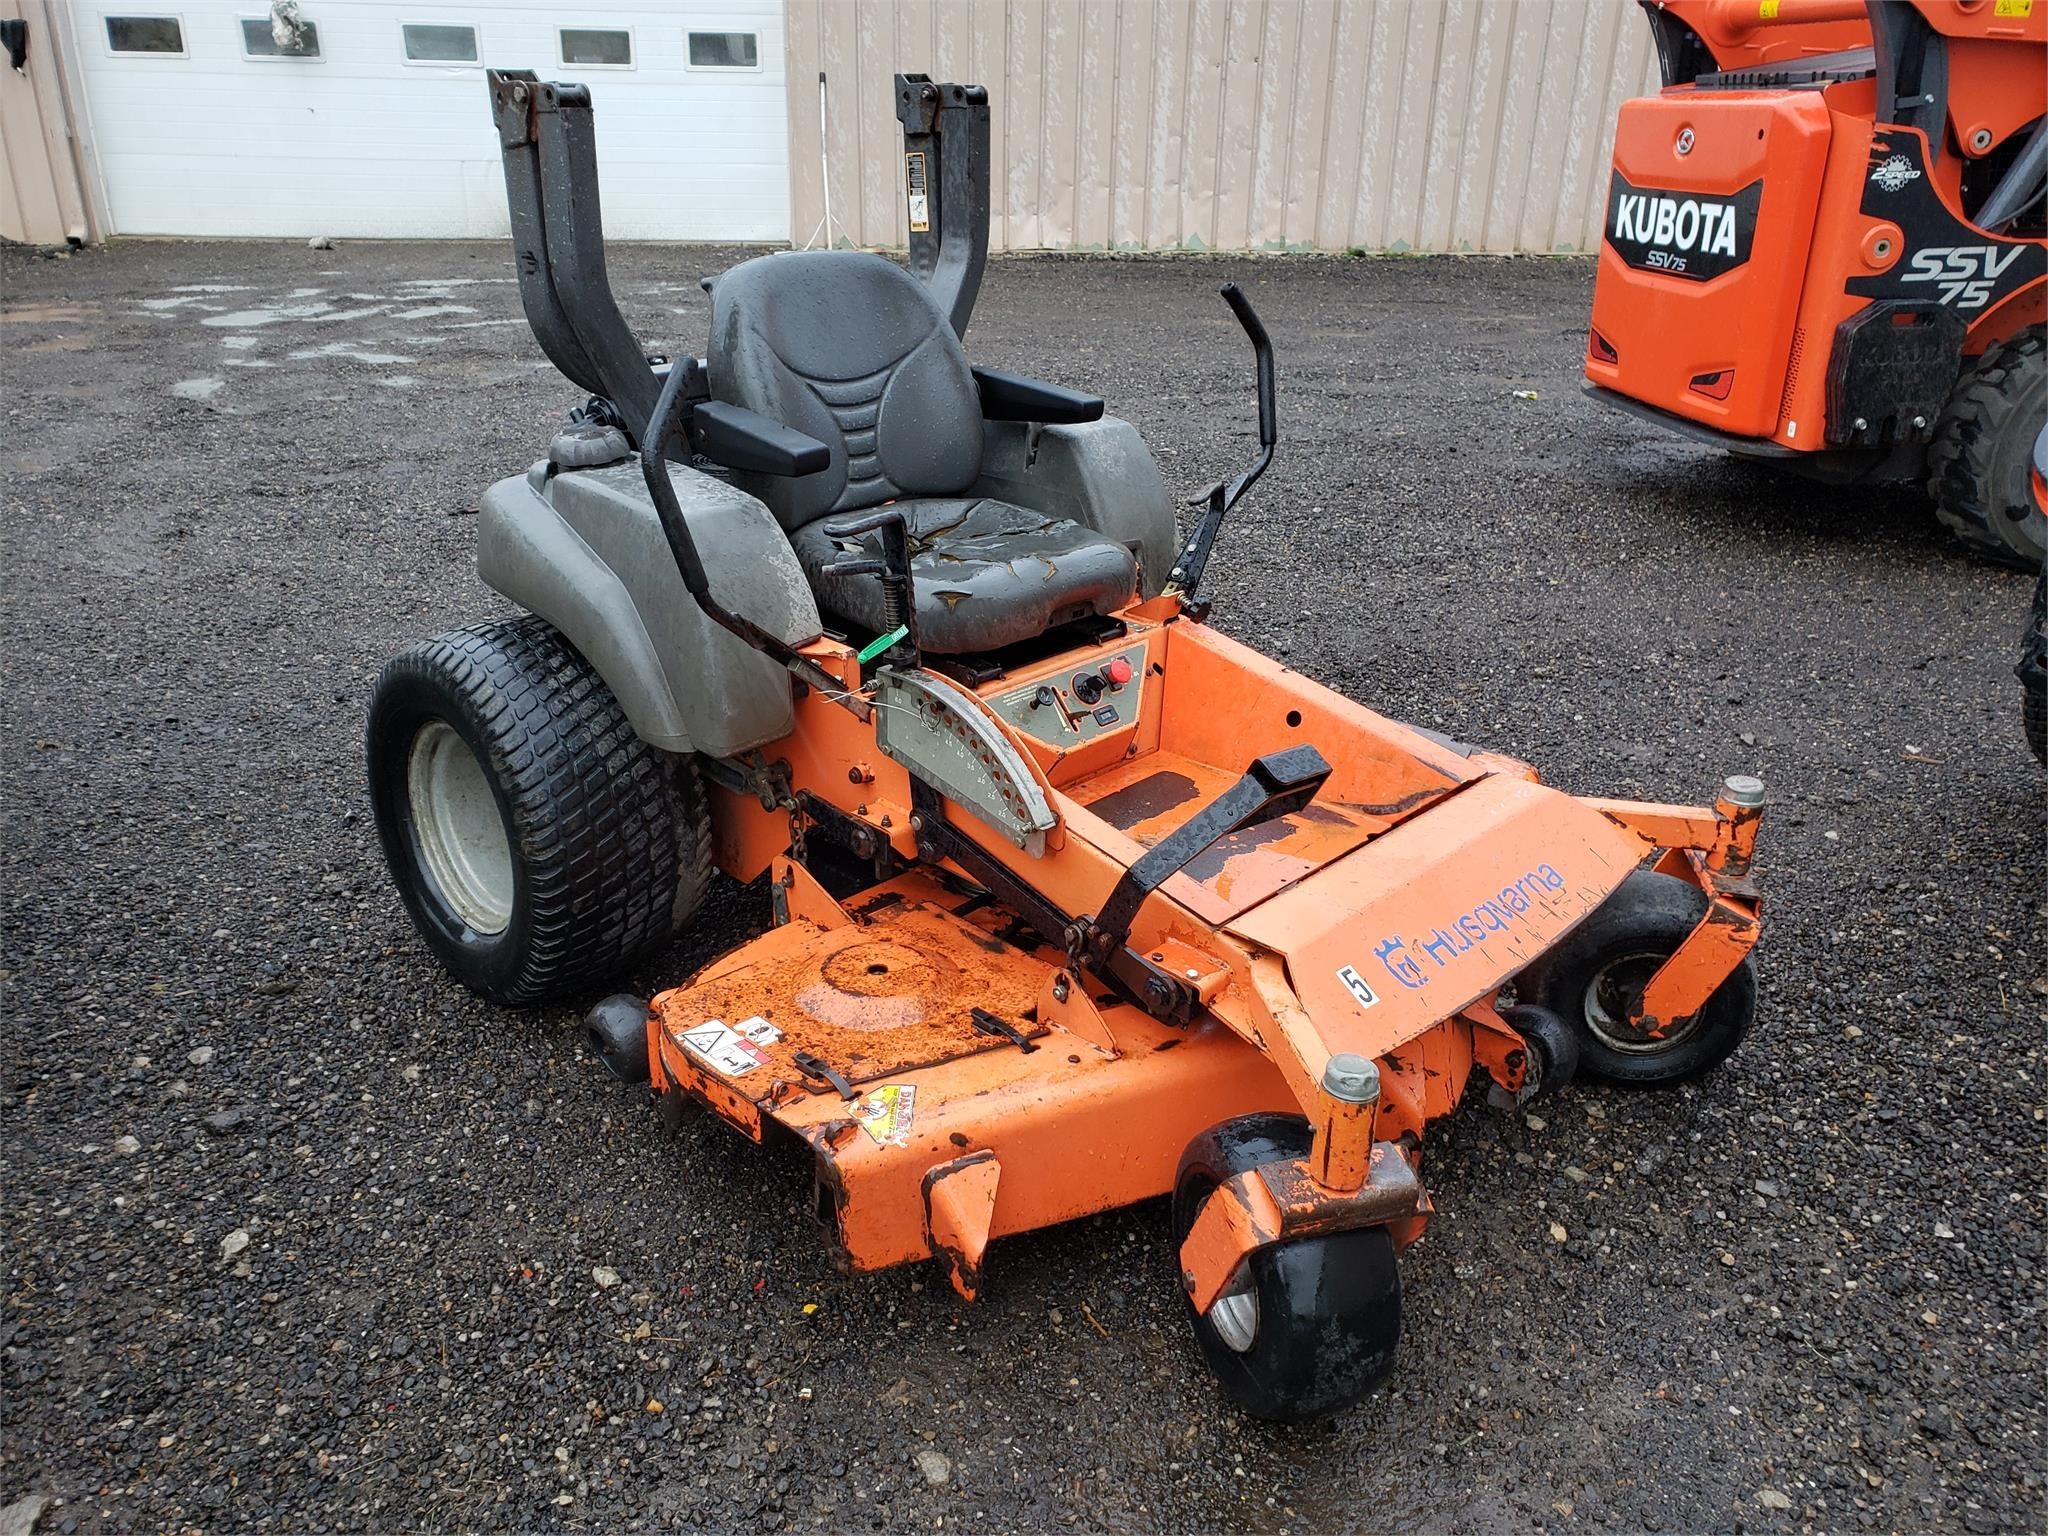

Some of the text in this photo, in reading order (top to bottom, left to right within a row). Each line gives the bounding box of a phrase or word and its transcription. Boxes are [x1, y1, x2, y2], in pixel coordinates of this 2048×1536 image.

[1615, 194, 1736, 257] KUBOTA
[1901, 245, 2027, 281] SSV
[1937, 280, 1995, 308] 75
[1422, 863, 1564, 967] Husqvarna
[1341, 968, 1373, 1003] 5
